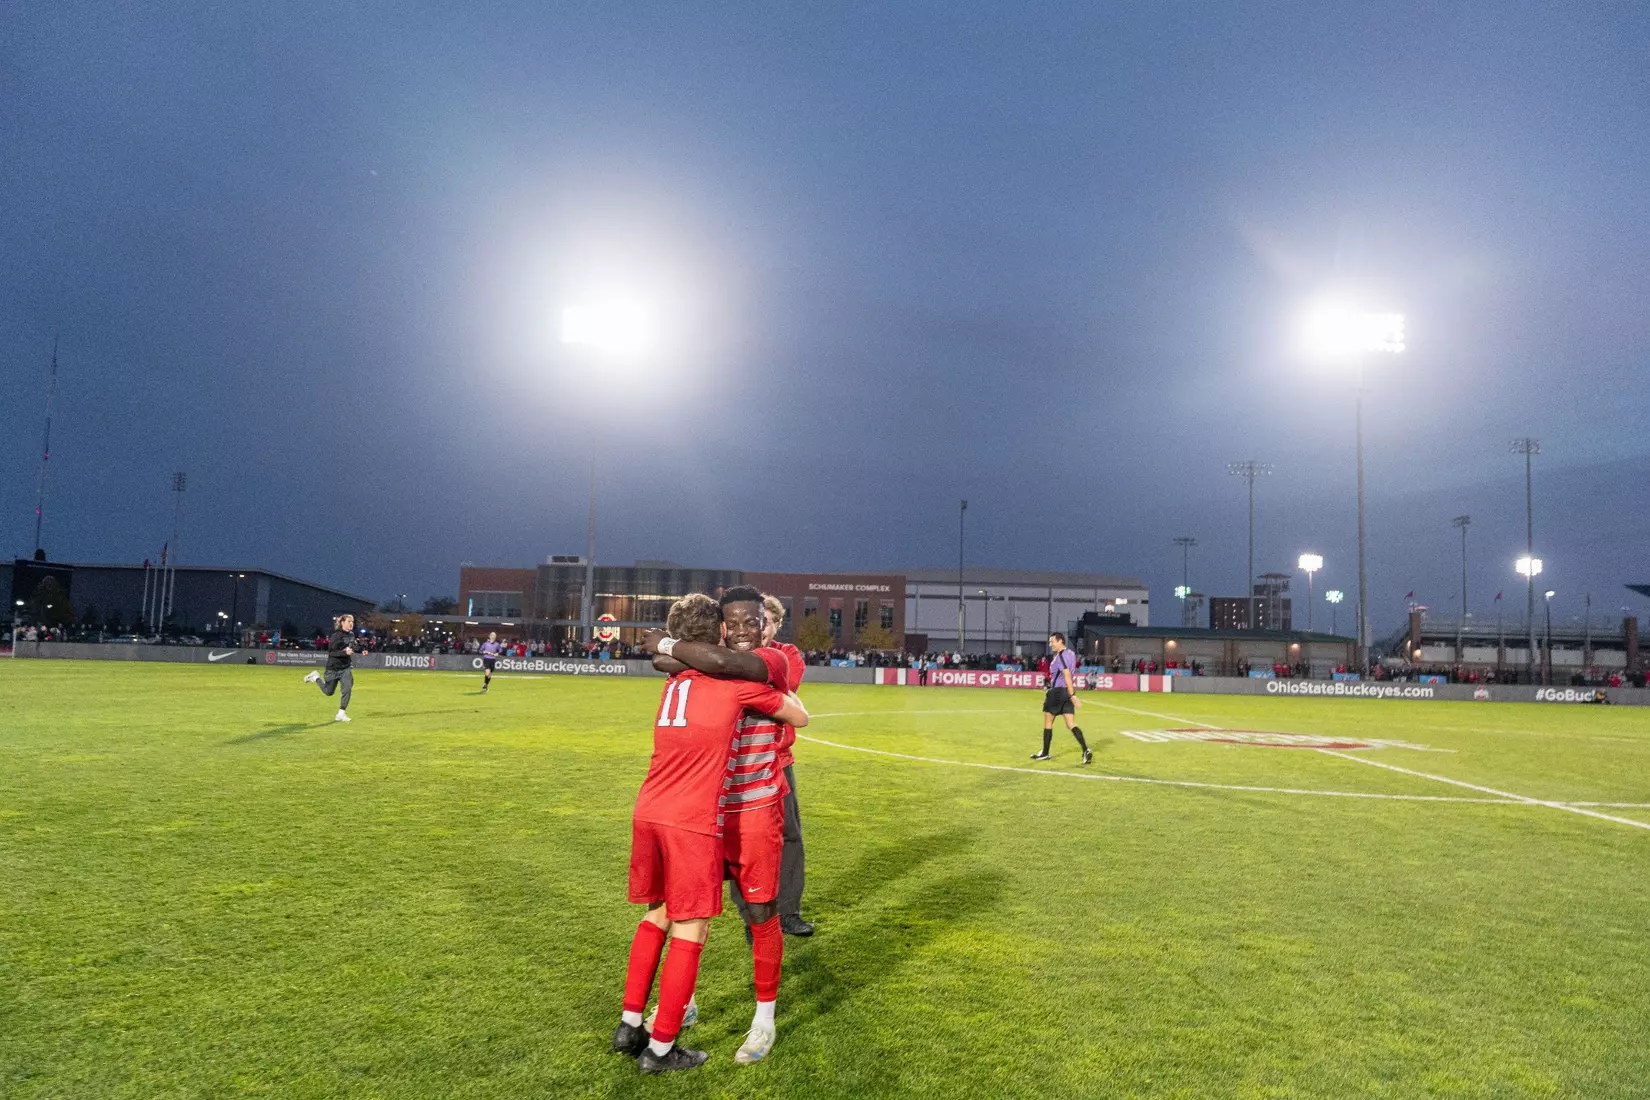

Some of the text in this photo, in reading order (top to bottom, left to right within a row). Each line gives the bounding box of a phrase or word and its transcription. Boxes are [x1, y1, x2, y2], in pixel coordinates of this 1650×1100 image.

[808, 583, 891, 592] SCHUMAKER COMPLEX
[385, 655, 430, 668] DONATOS
[472, 657, 626, 675] OoStateBuckeyes.com
[932, 672, 1114, 689] HOME OF THE BKEES
[1266, 681, 1434, 698] OhioStateBuckeyes.com
[657, 679, 692, 727] 11
